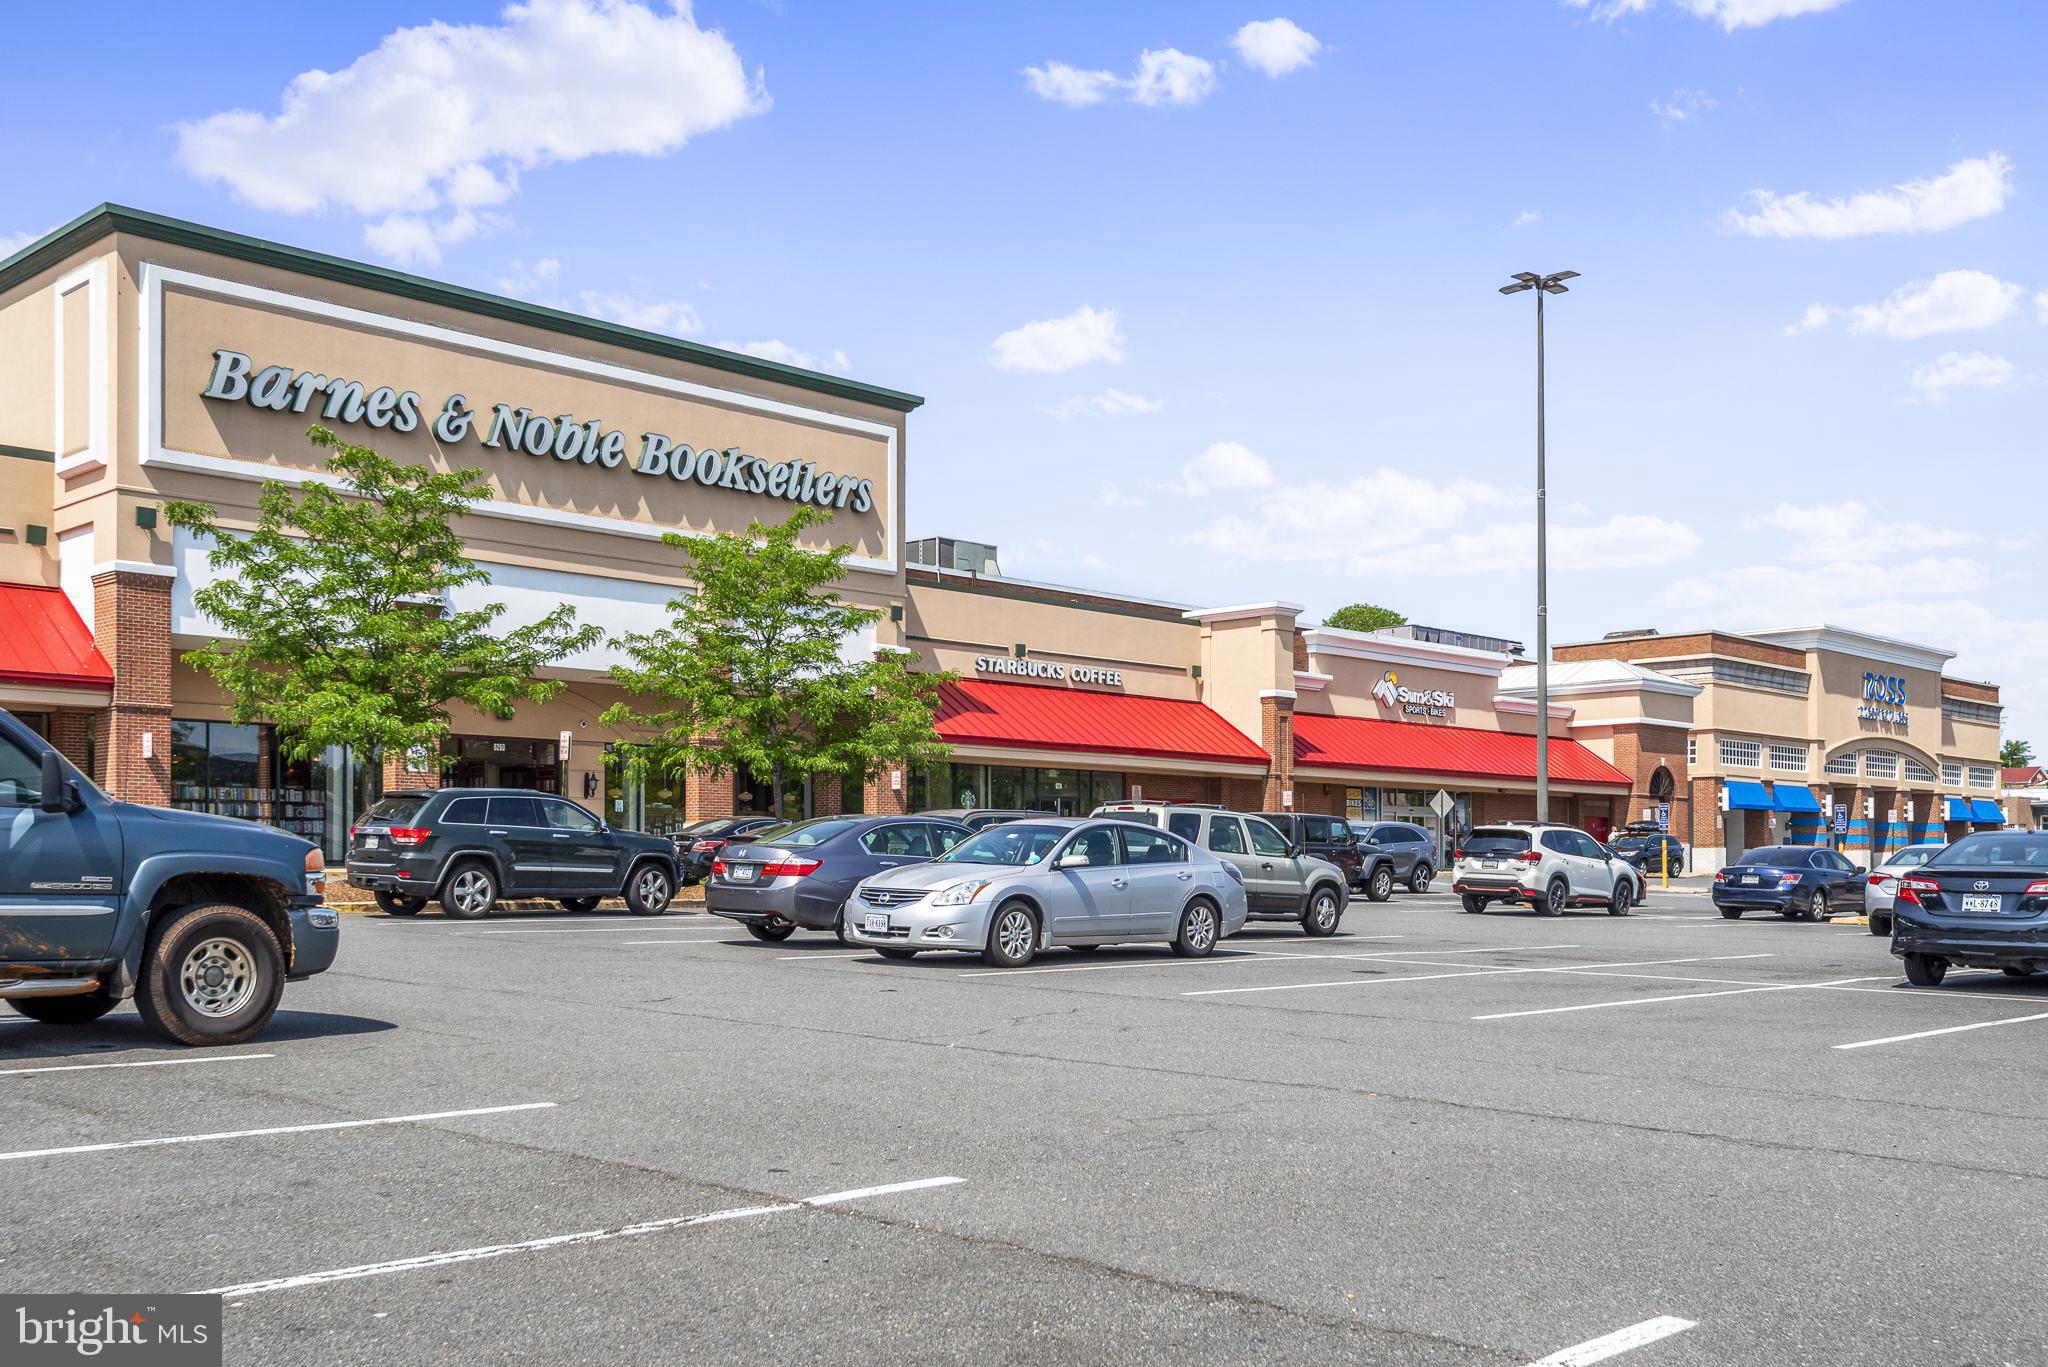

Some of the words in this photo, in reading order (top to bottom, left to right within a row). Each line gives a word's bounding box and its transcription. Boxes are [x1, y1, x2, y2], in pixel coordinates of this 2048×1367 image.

[200, 349, 421, 433] Barnes
[432, 393, 475, 443] &
[481, 402, 626, 469] Noble
[632, 432, 873, 513] Booksellers
[976, 655, 1065, 680] STARBUCKS
[1069, 665, 1122, 686] COFFEE
[1862, 671, 1906, 706] ROSS
[1405, 705, 1427, 716] SPORTS
[1429, 706, 1447, 717] BIKES
[1346, 799, 1362, 807] BIKES
